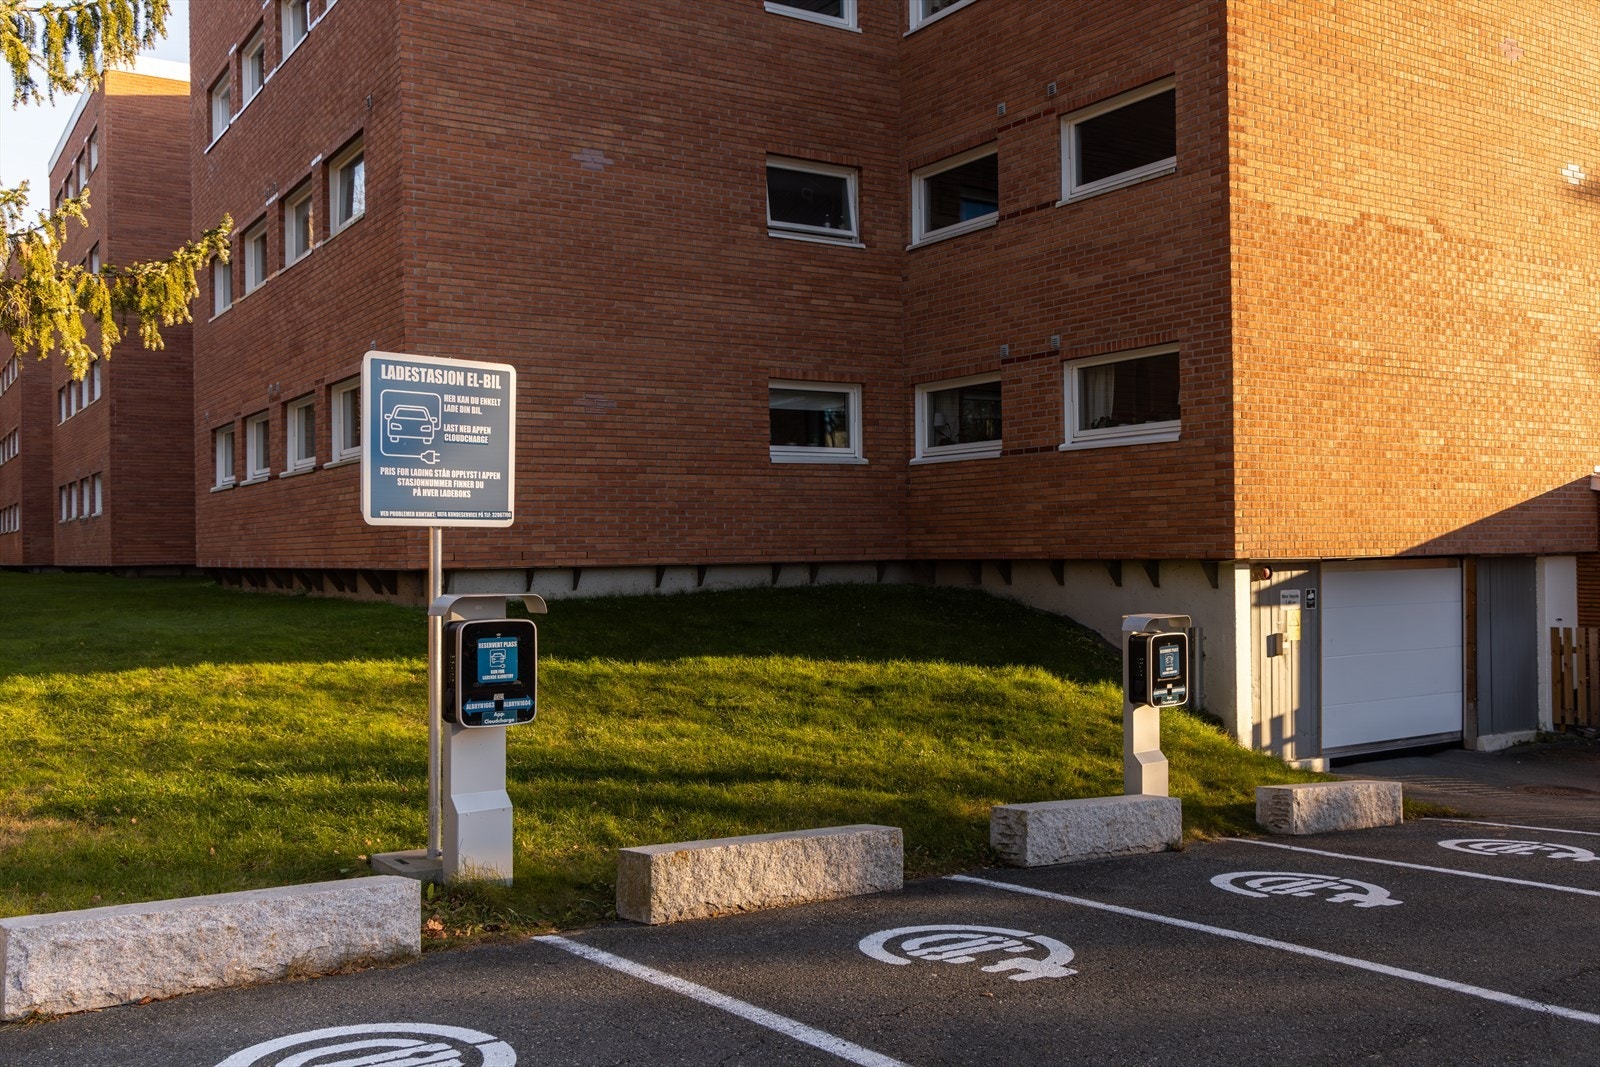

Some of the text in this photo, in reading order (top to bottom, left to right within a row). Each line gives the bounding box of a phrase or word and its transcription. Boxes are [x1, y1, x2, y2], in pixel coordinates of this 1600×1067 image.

[381, 364, 501, 389] LADESTASJON EL-BIL
[444, 394, 501, 406] HER KAN DU ENKELT
[444, 404, 458, 412] LADE
[460, 405, 470, 413] DIN
[444, 424, 491, 434] LAST NED APPEN
[444, 433, 488, 443] CLOUDCHARGE
[380, 467, 395, 475] PRIS
[397, 468, 409, 476] FOR
[411, 468, 433, 477] LADING
[434, 468, 450, 478] STÅR
[452, 470, 477, 479] OPPLYST
[482, 471, 500, 480] APPEN
[397, 478, 484, 488] STASJONNUMMER FINNER DU
[413, 488, 471, 498] PÅ HVER LADEBOKS
